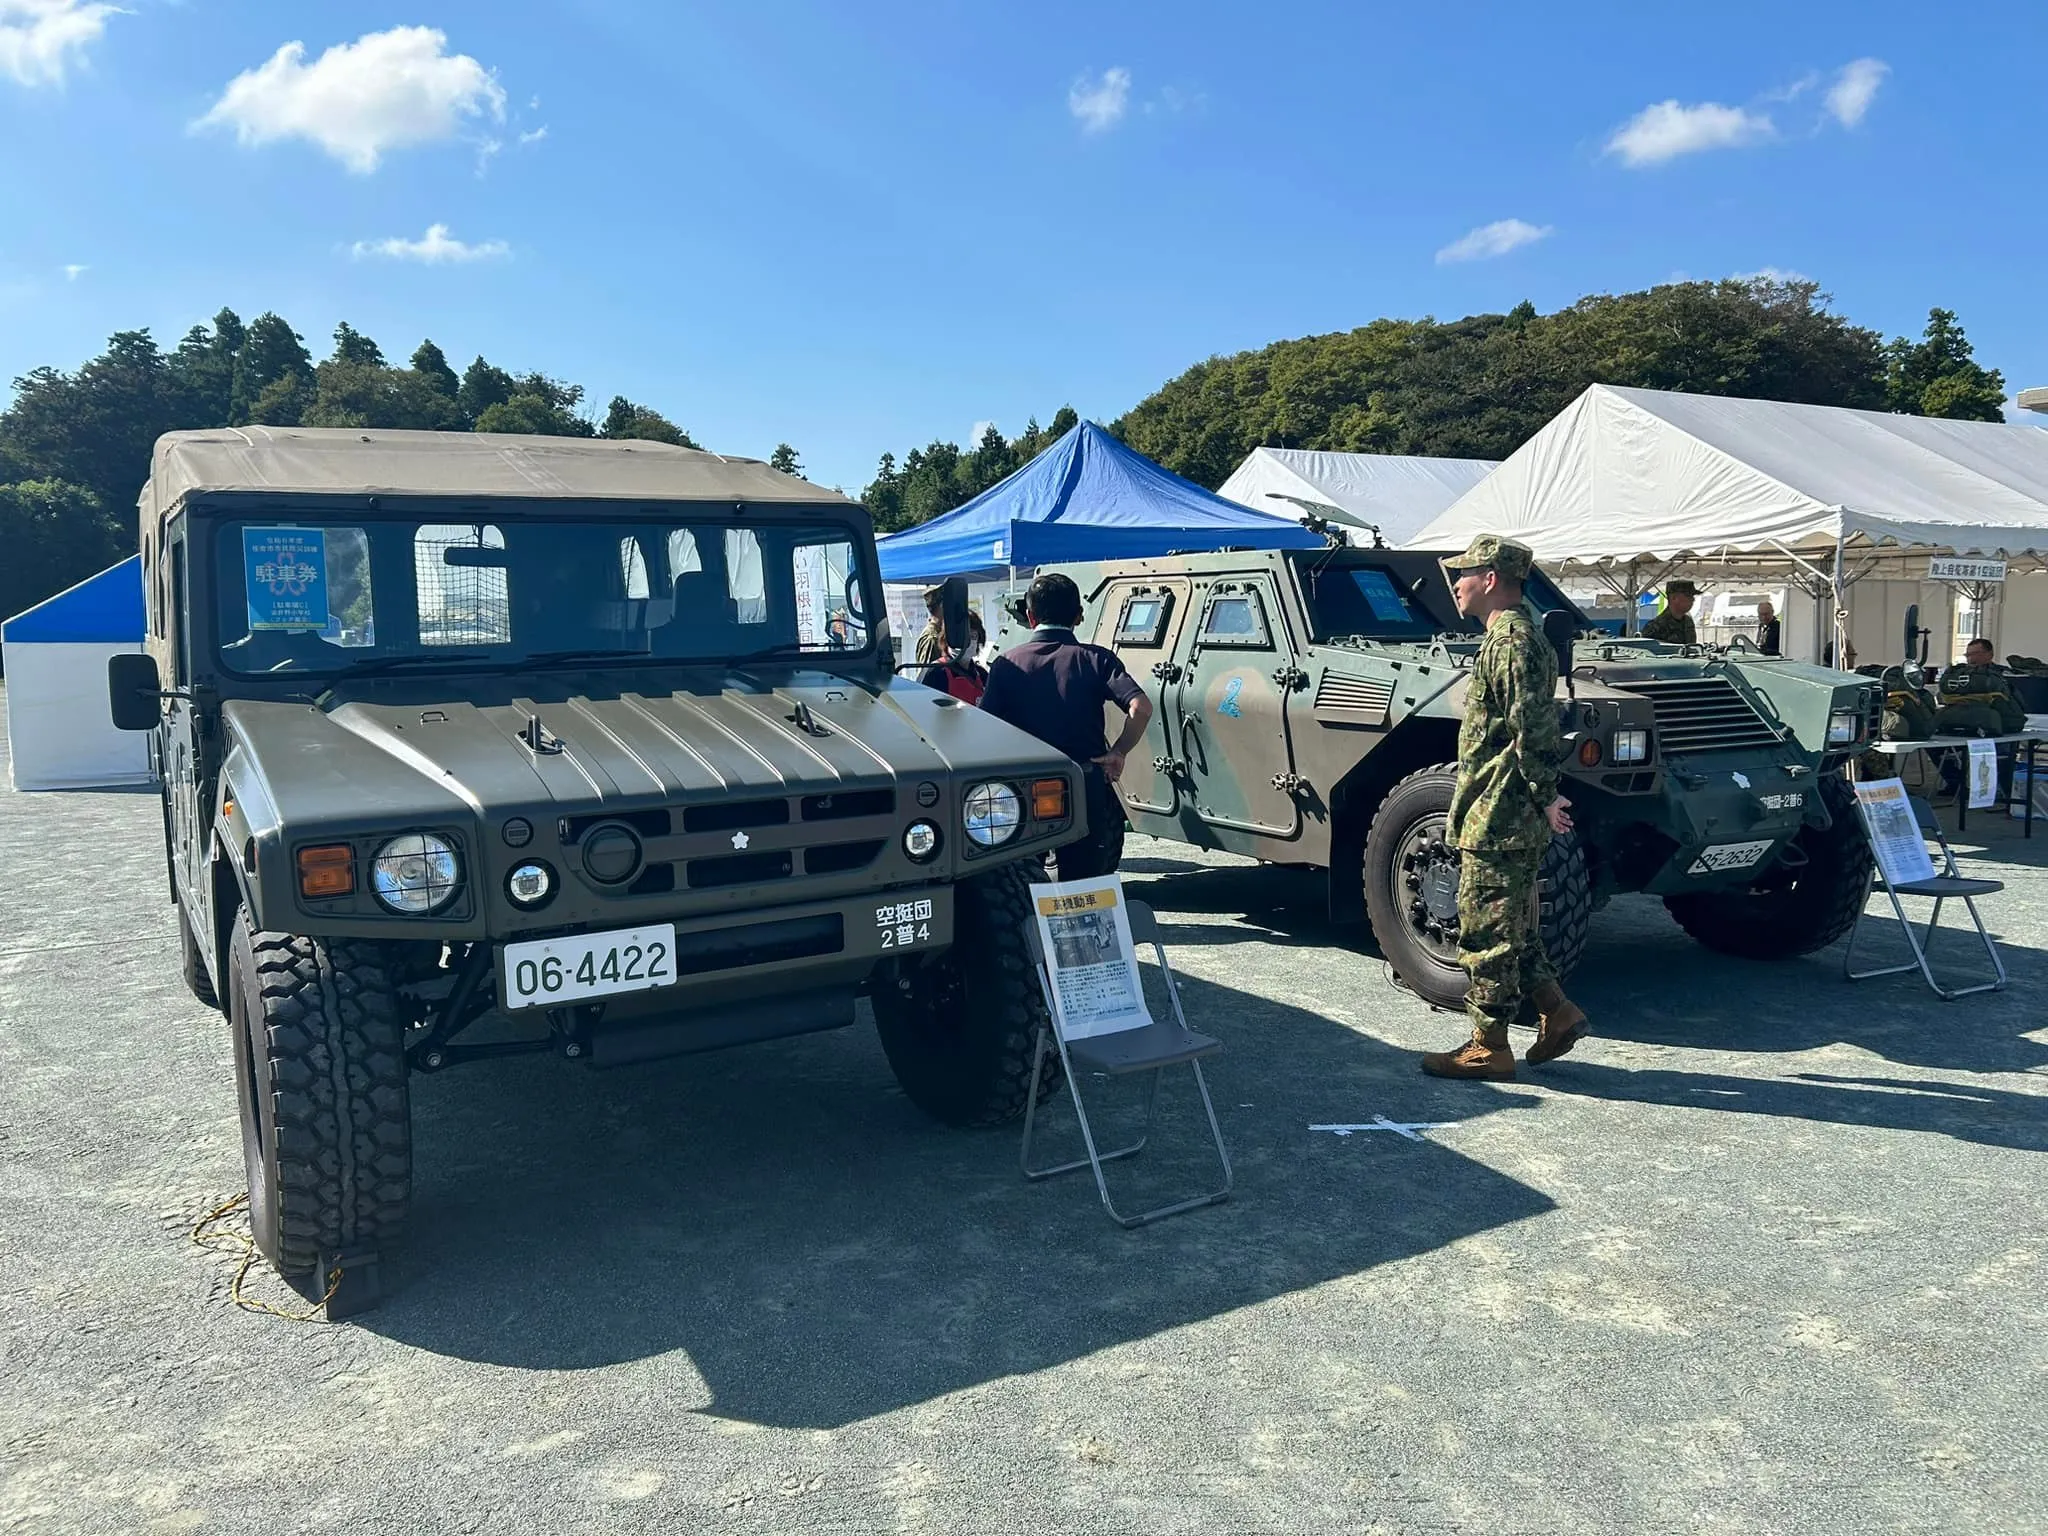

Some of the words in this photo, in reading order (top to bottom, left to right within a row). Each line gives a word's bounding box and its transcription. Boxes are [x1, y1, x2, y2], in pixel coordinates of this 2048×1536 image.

[255, 565, 318, 583] 駐車券
[876, 899, 932, 927] 空挺団
[516, 942, 668, 996] 06-4422
